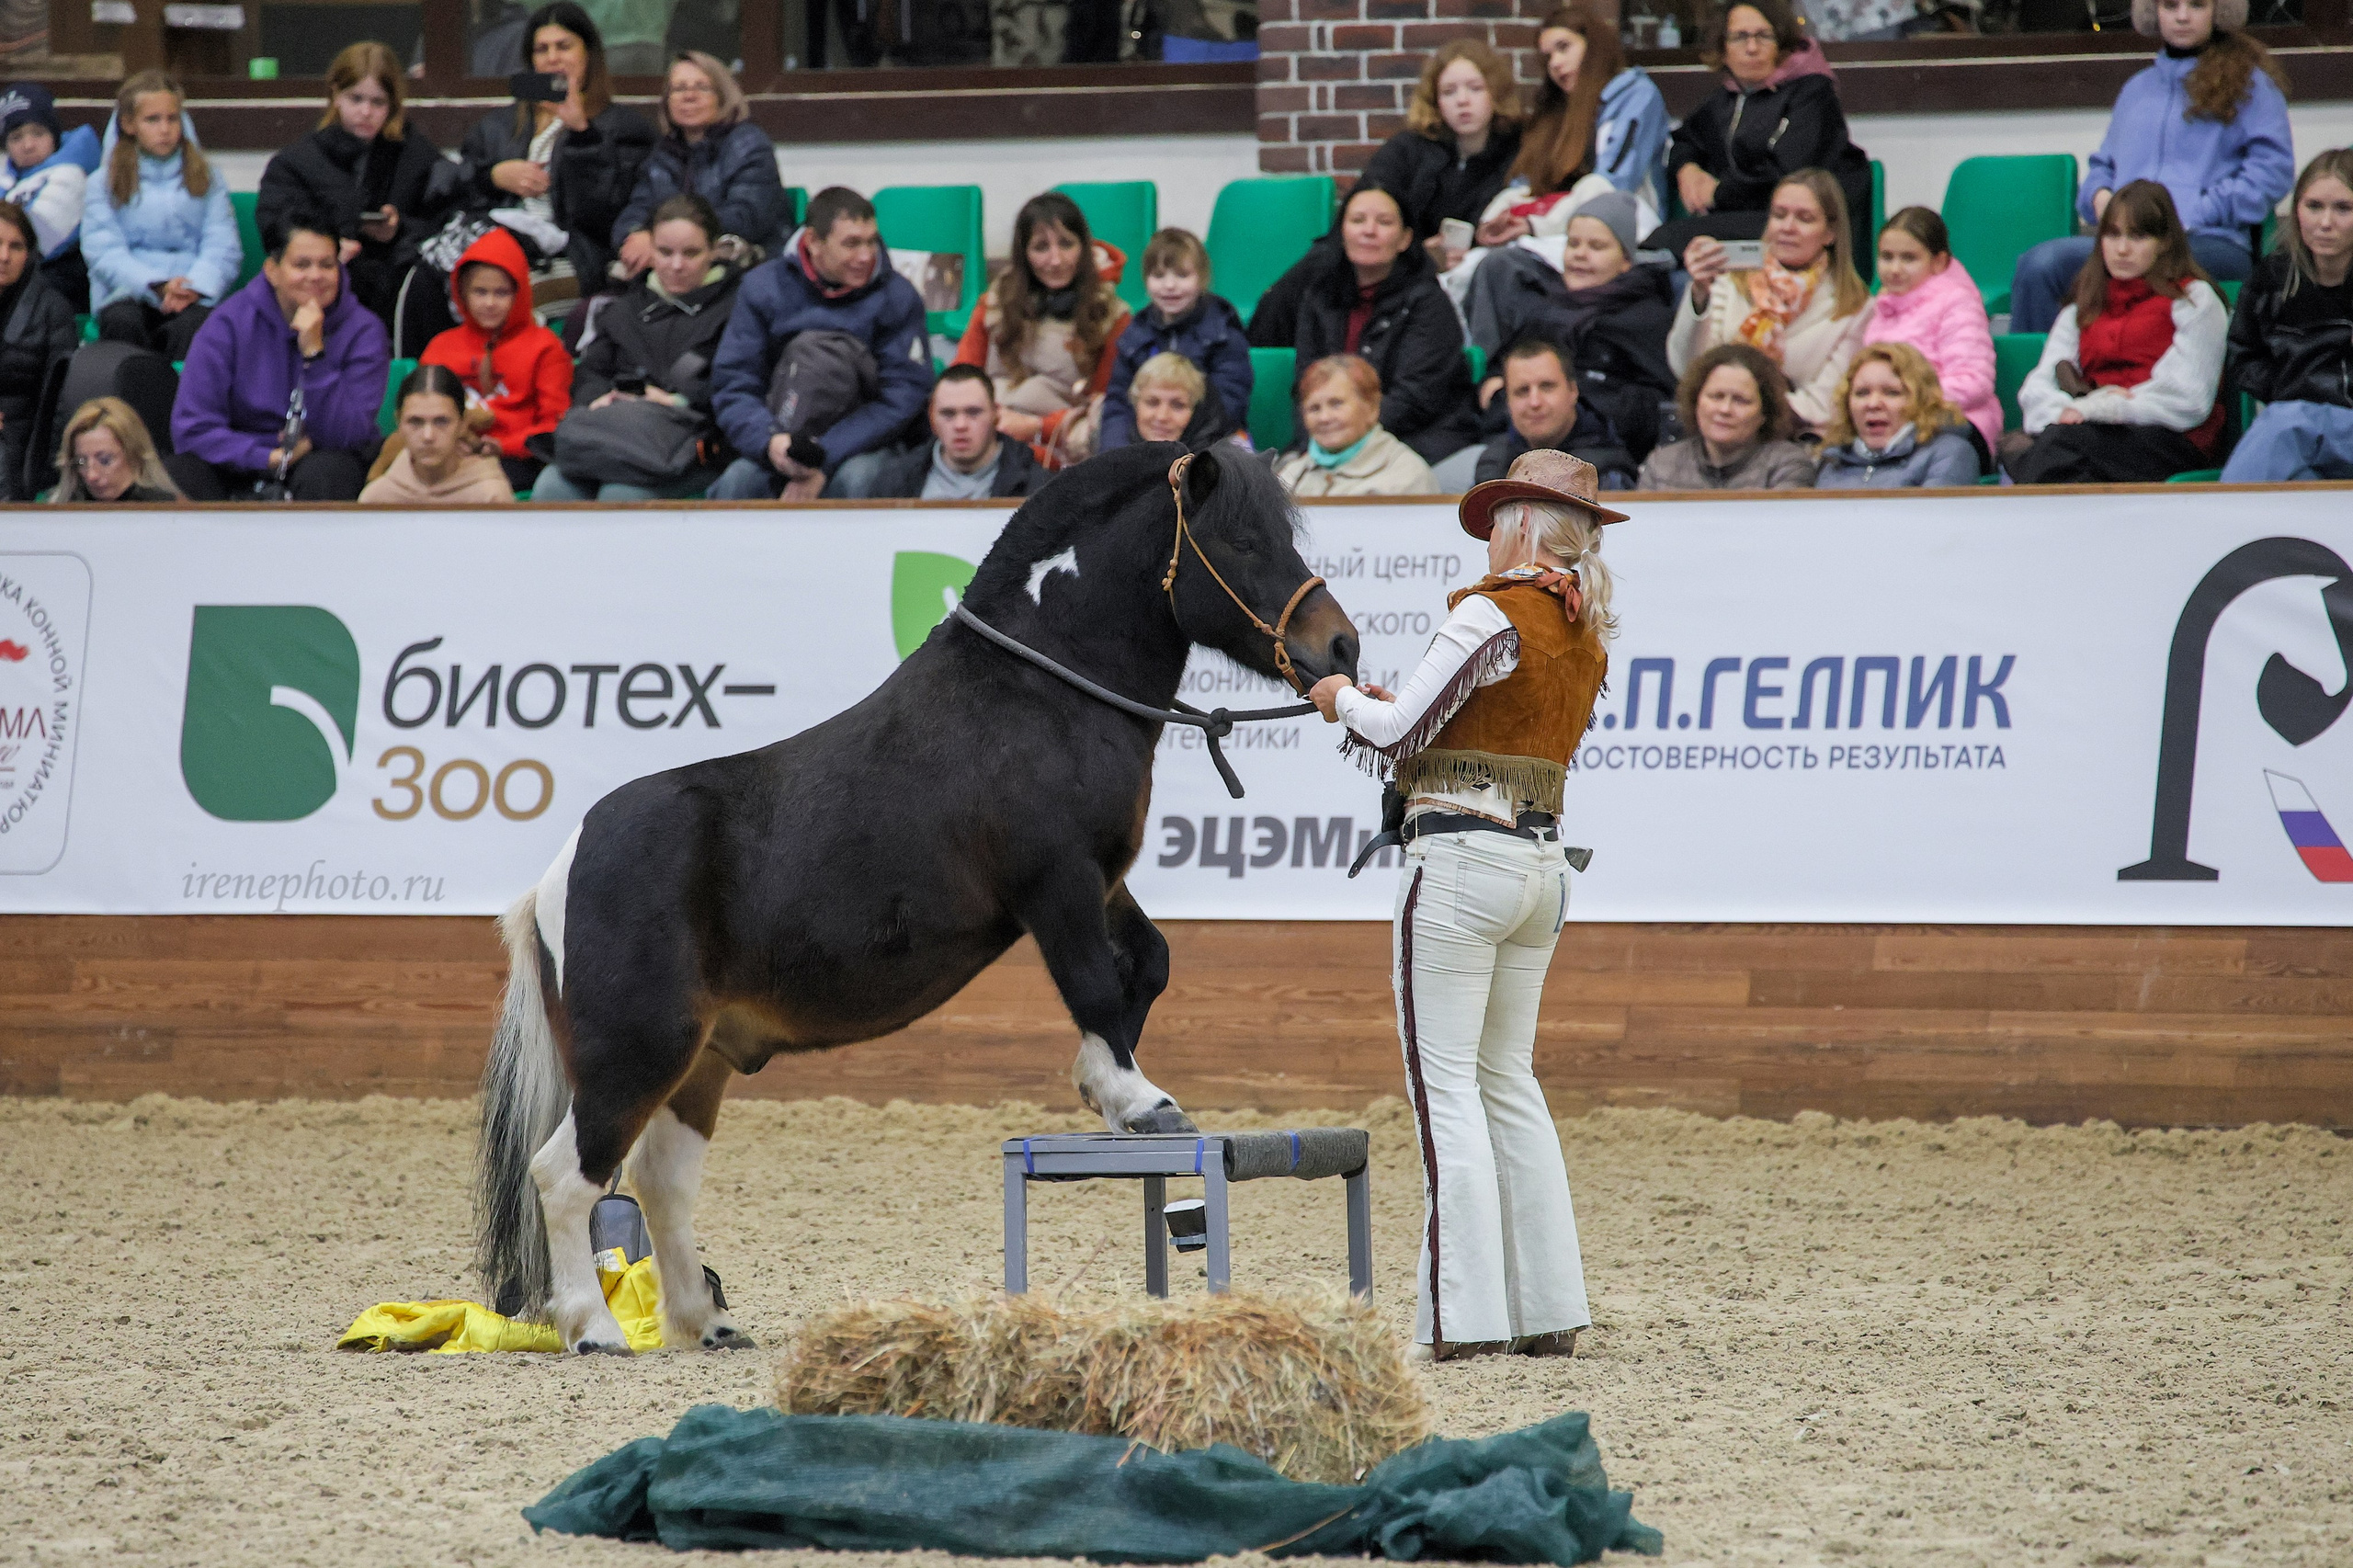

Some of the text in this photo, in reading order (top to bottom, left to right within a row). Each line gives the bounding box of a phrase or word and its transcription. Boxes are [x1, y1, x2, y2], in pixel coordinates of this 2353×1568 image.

[1374, 553, 1461, 586] центр
[0, 572, 22, 605] КА
[22, 597, 73, 693] КОННОЙ
[1571, 744, 2006, 772] ОСТОВЕРНОСТЬ РЕЗУЛЬТАТА
